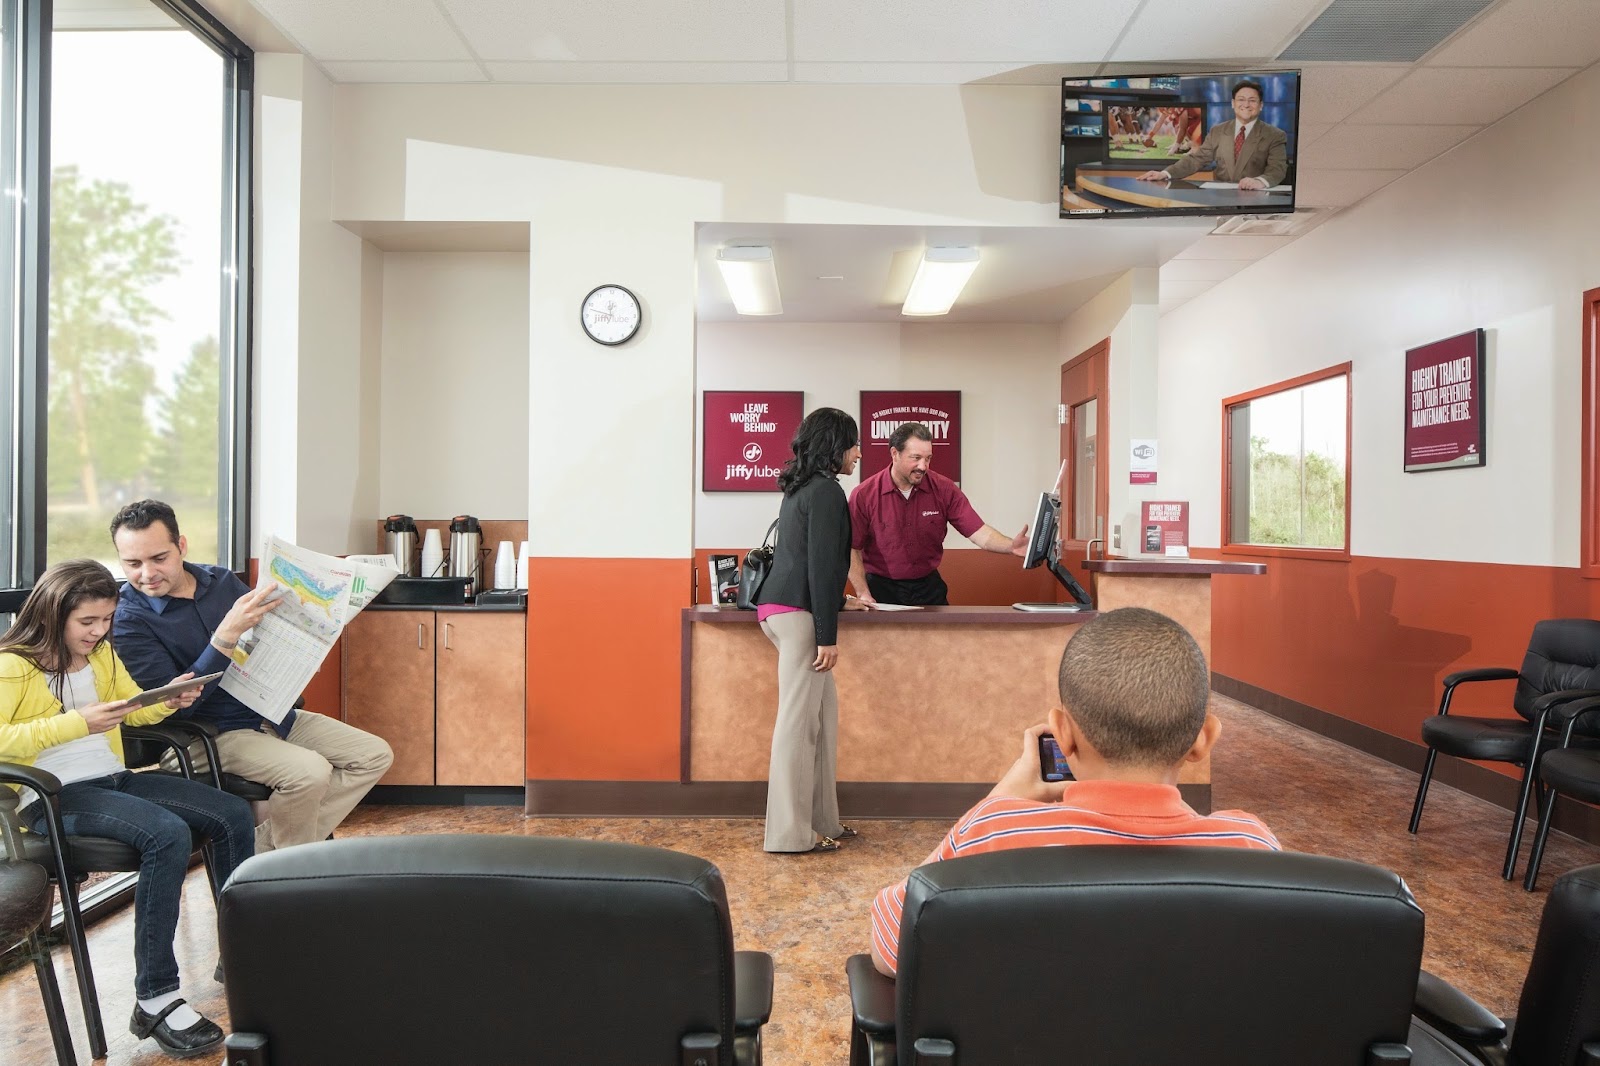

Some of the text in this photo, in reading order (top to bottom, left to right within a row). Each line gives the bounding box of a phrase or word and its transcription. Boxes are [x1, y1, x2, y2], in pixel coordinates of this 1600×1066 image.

[1412, 356, 1471, 393] HIGHLY TRAINED
[1412, 381, 1472, 410] FOR YOUR PREVENTIVE
[730, 412, 761, 423] WORRY
[744, 403, 769, 413] LEAVE
[1412, 405, 1450, 428] MAINTENANCE
[871, 420, 950, 439] UNIITY
